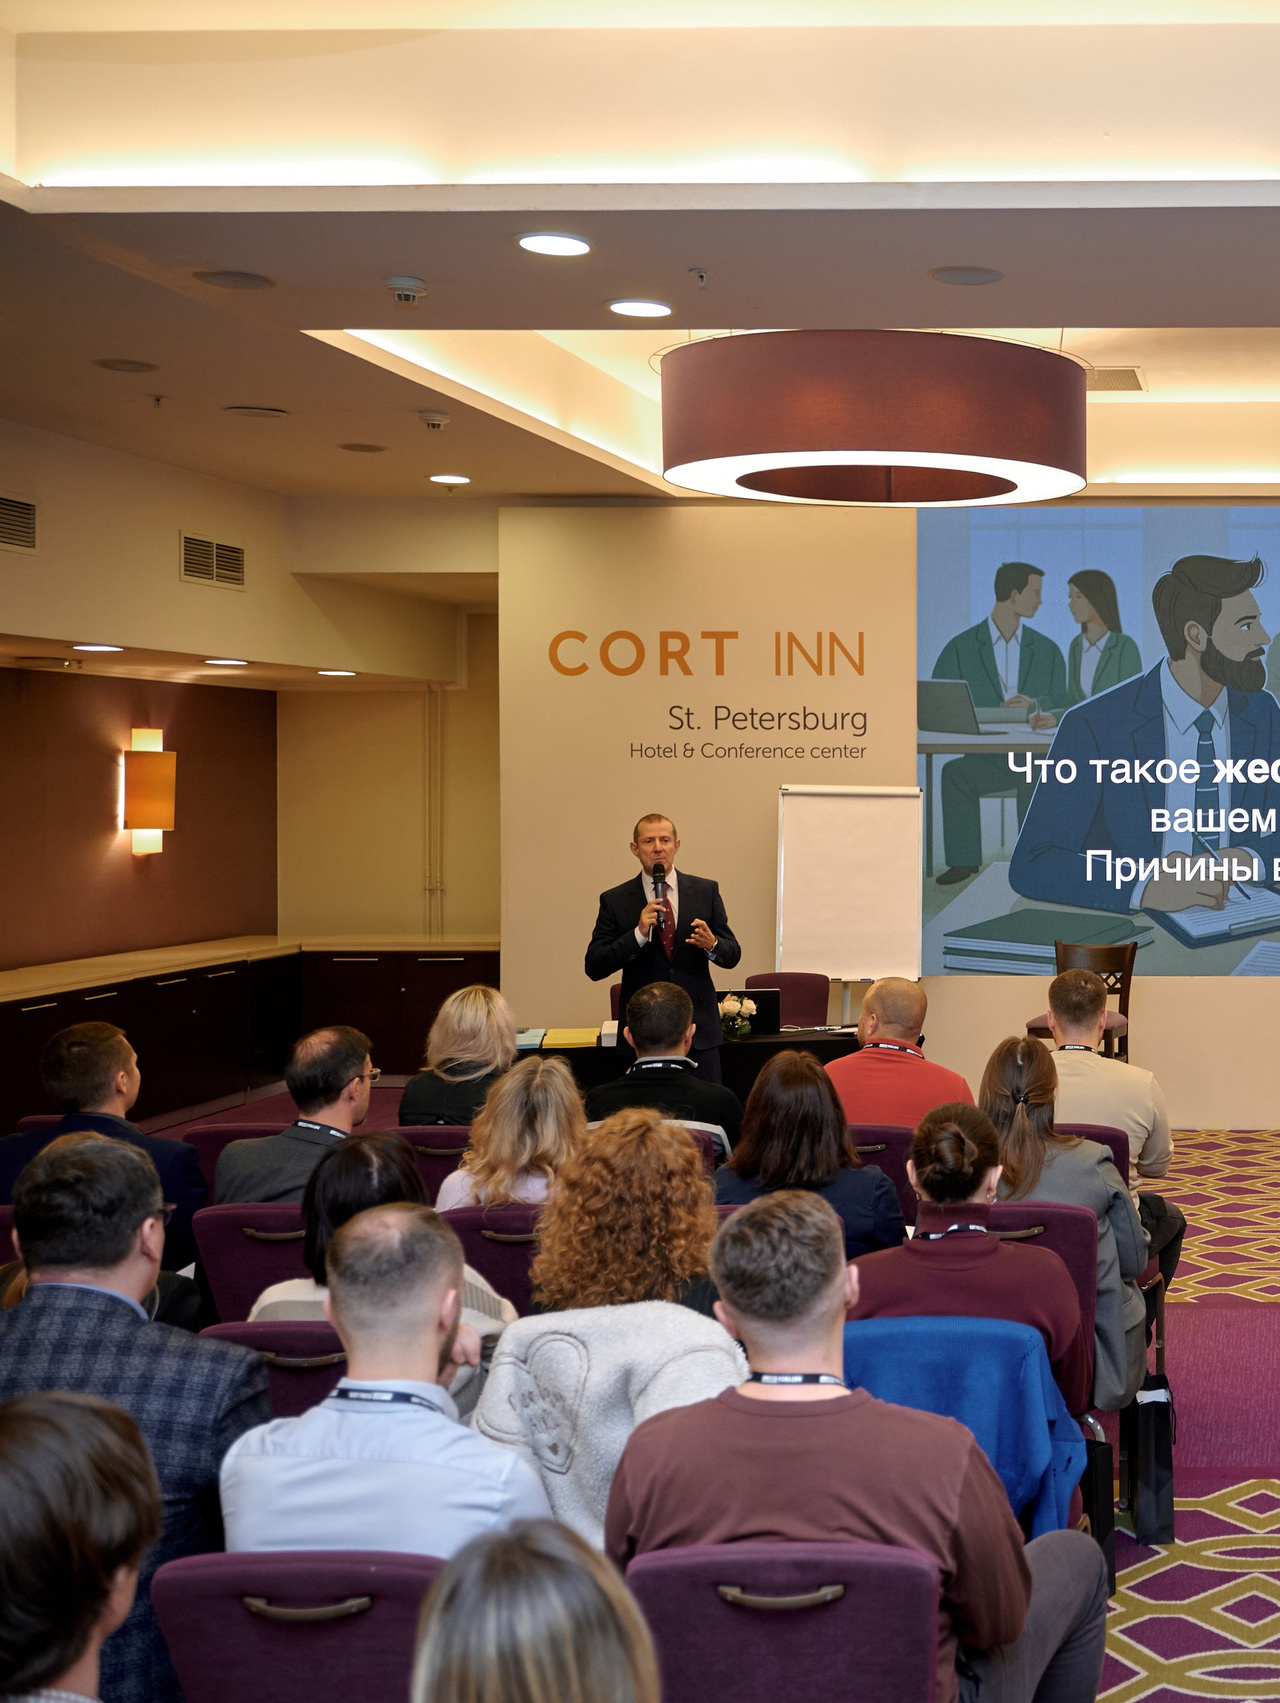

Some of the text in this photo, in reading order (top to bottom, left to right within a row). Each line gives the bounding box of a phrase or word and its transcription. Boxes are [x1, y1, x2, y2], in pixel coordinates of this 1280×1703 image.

[548, 630, 866, 677] CORT INN
[668, 705, 867, 737] St. Petersburg
[630, 742, 867, 759] Hotel & Conference center
[1008, 751, 1077, 784] Что
[1089, 759, 1201, 784] такое
[1151, 808, 1276, 833] вашем
[1086, 849, 1259, 889] Причины
